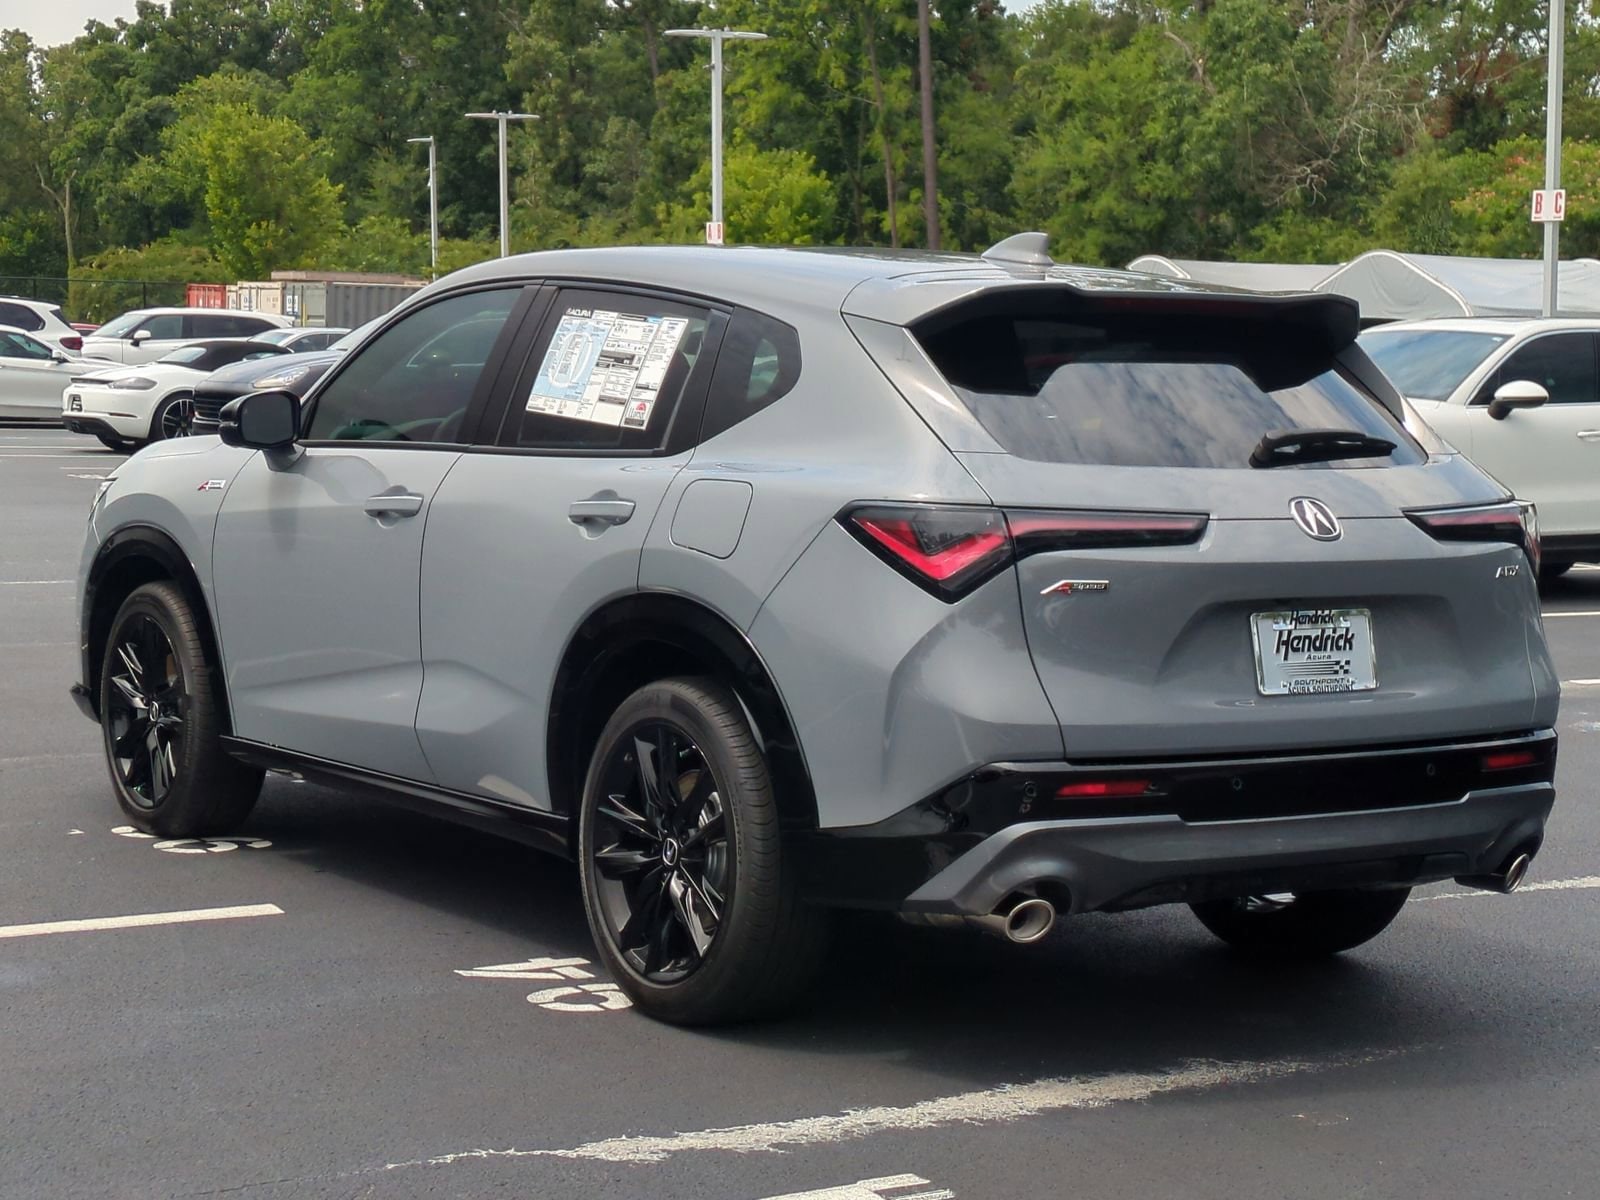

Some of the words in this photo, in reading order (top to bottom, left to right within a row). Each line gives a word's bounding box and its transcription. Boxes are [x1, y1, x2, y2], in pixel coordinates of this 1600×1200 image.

[1535, 192, 1543, 214] B
[1554, 191, 1563, 214] C
[1290, 609, 1335, 629] Hendrick
[1274, 627, 1355, 661] Hendrick
[1306, 653, 1332, 661] Acura
[1294, 677, 1345, 686] SOUTHPOINT
